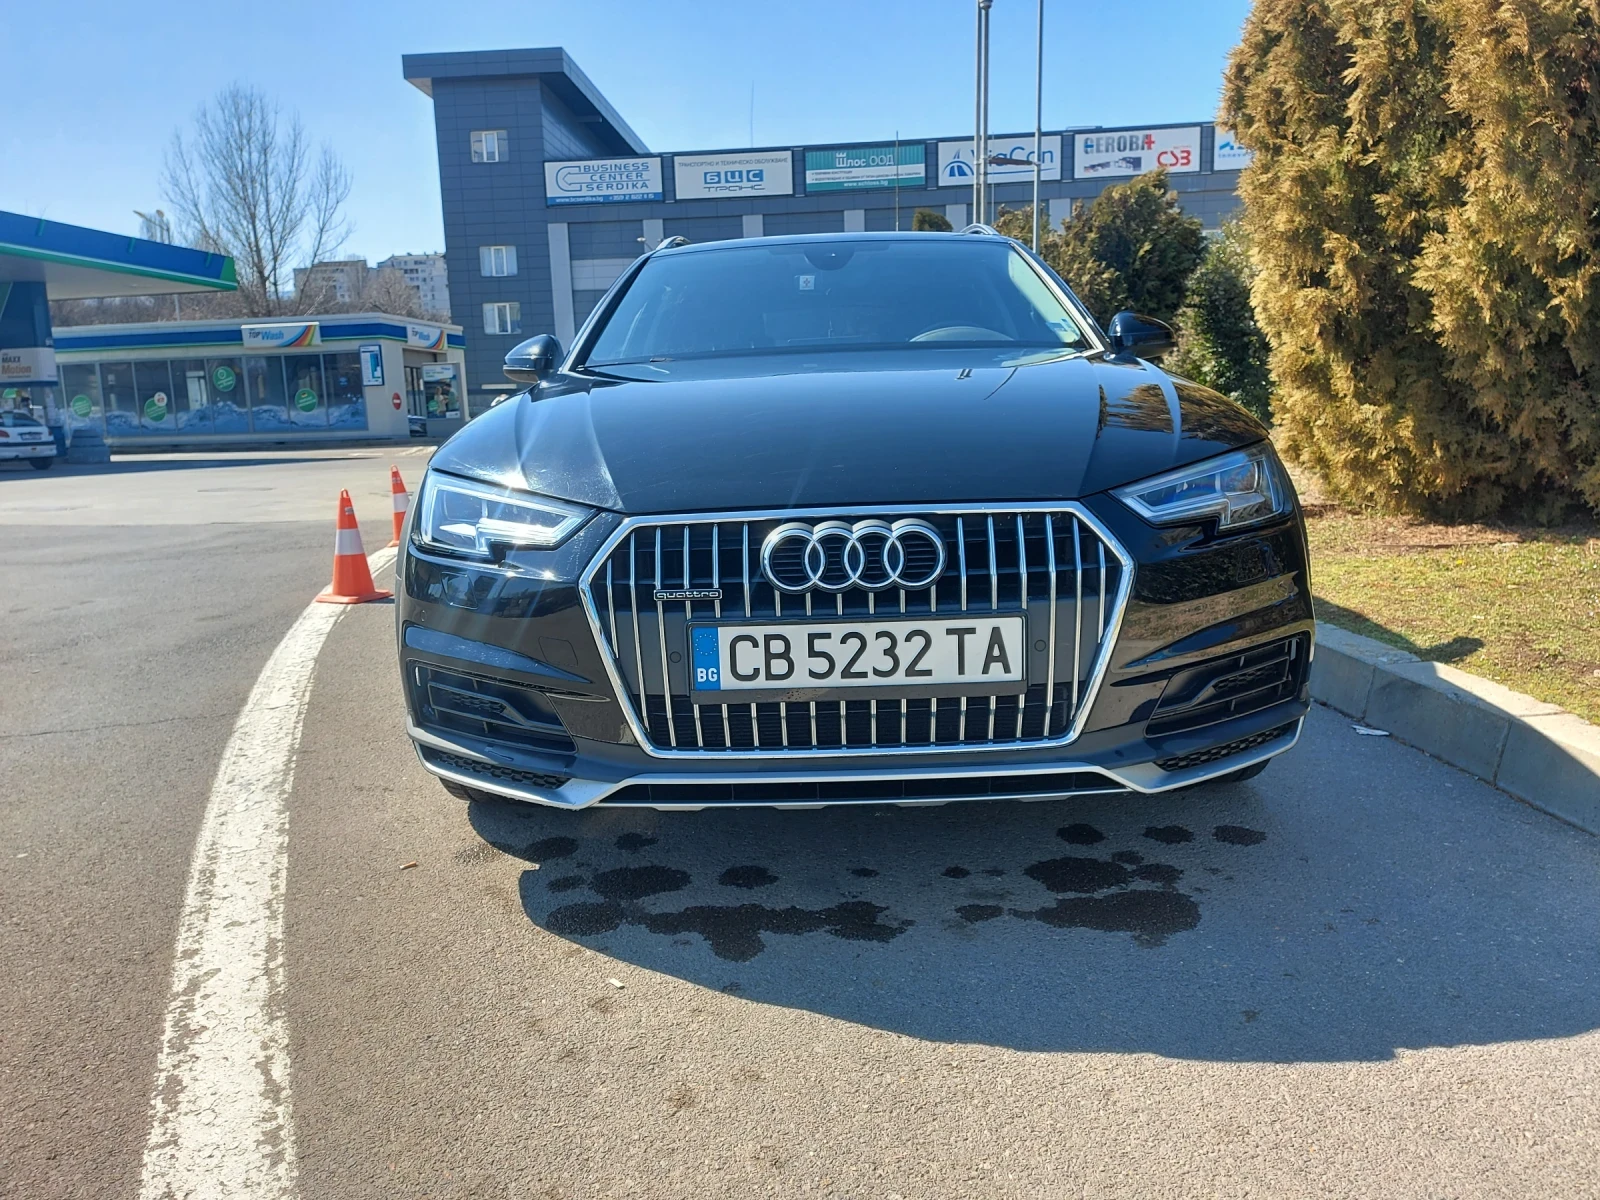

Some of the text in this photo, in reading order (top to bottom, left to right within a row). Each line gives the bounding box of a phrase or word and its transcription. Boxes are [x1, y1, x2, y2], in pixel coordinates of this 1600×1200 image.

[835, 154, 894, 168] Шлос ООД
[583, 162, 650, 173] BUSINESS
[590, 172, 644, 182] CENTER
[585, 181, 650, 192] SERDIKA
[703, 184, 766, 192] ТРАНС
[248, 330, 284, 341] TOP Wash
[1, 355, 21, 363] MAXX
[1, 364, 32, 375] Motion
[656, 591, 719, 600] quattro
[728, 626, 1012, 682] CB 5232 TA
[696, 667, 718, 682] BG
